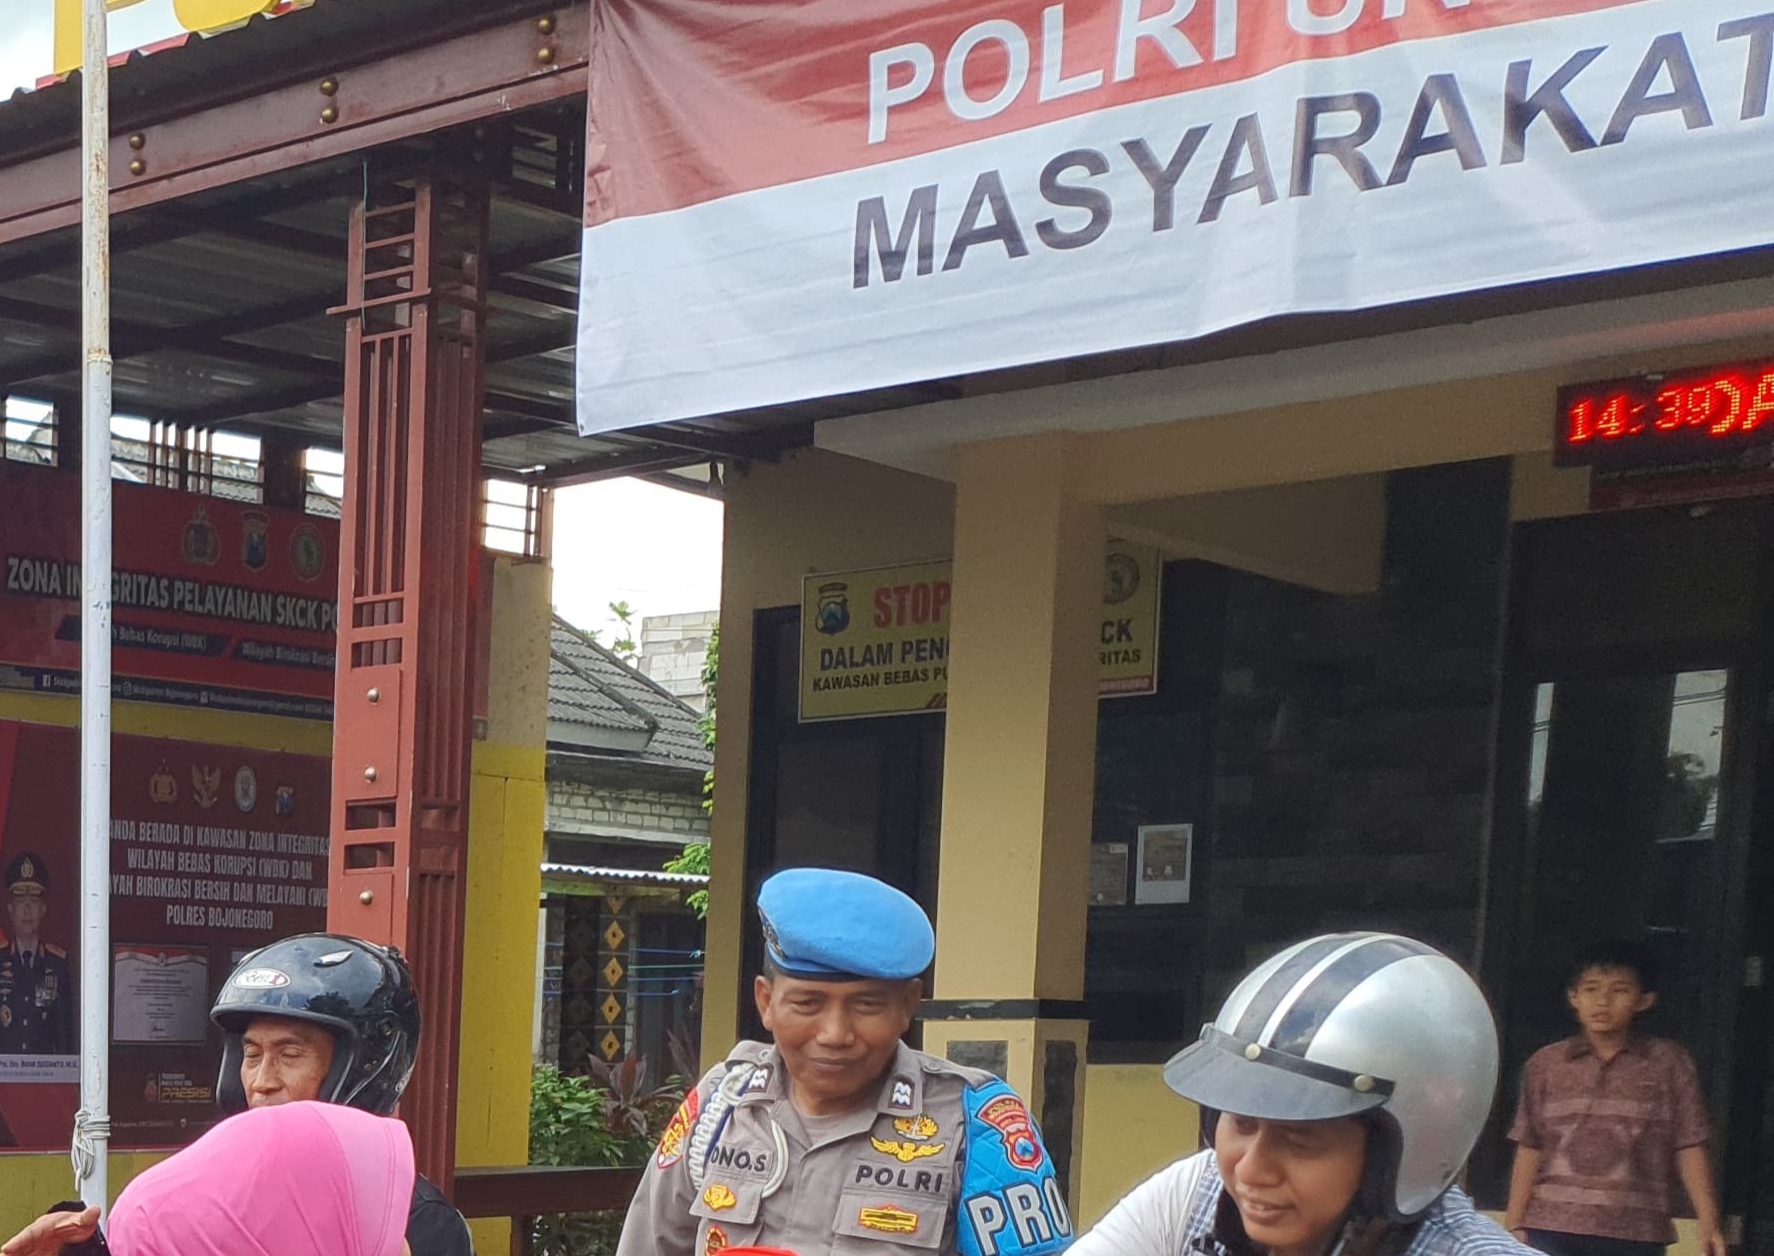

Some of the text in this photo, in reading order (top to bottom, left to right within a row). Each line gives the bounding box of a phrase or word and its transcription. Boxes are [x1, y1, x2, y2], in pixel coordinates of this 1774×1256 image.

[867, 0, 1239, 145] POLRI
[852, 12, 1774, 290] MASYARAKAT
[1568, 386, 1710, 442] 14:39
[7, 557, 62, 596] ZONA
[173, 580, 272, 622] PELAYANAN
[276, 594, 317, 630] SKCK
[874, 581, 952, 629] STOP
[820, 642, 893, 671] DALAM
[901, 637, 950, 663] PEN
[813, 672, 879, 691] KAWASAN
[884, 668, 929, 685] BEBAS
[139, 821, 177, 844] BERADA
[183, 825, 194, 846] DI
[197, 826, 246, 849] KAWASAN
[249, 830, 274, 852] ZONA
[128, 848, 312, 880] WILAYAH BEBAS KORUPSI (WBK) DAN
[137, 876, 191, 898] BIROKRASI
[194, 880, 230, 901] BERSIH
[233, 882, 253, 904] DAN
[256, 884, 306, 906] MELAYANI
[166, 904, 274, 930] POLRES BOJONEGORO
[854, 1164, 943, 1193] POLRI
